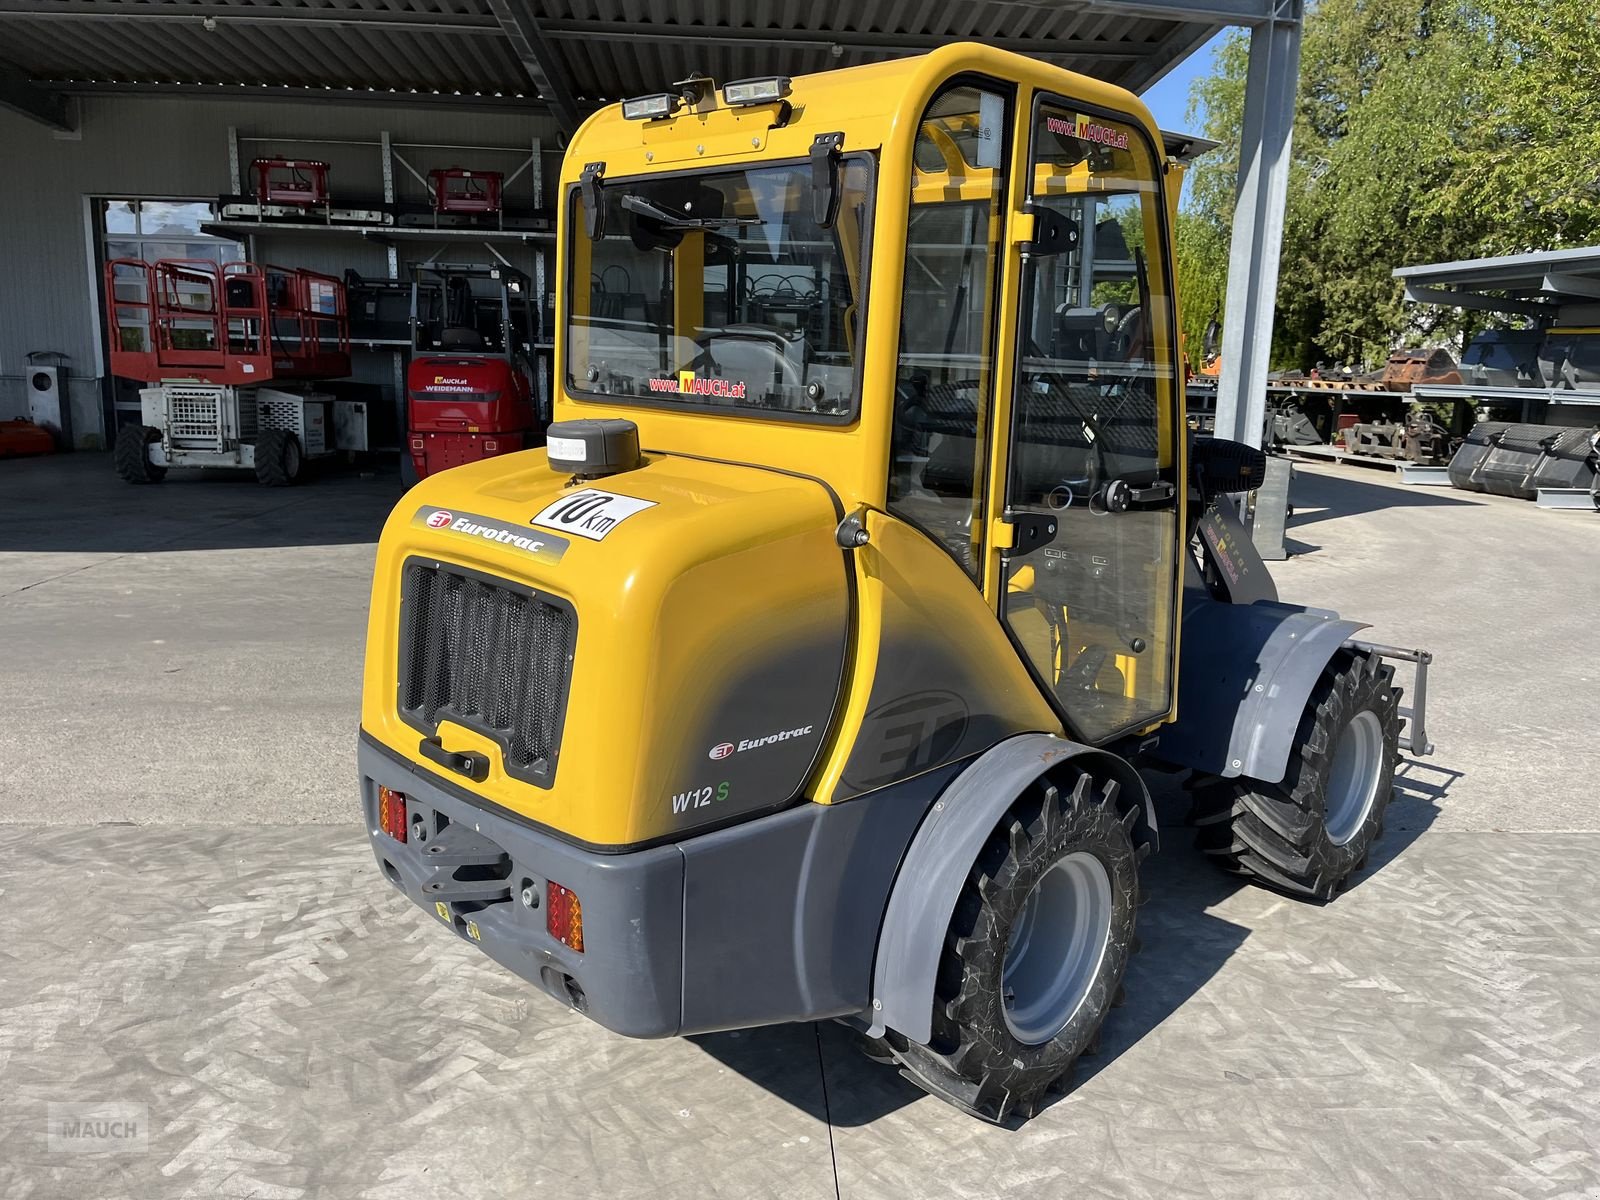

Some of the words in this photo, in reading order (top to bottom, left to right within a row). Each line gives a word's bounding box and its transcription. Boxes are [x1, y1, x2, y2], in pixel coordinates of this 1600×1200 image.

[1047, 116, 1128, 149] www.MAUCH.at
[425, 385, 473, 393] WEIDEMANN
[649, 377, 745, 399] www.MAUCH.at
[548, 493, 614, 524] 10
[451, 517, 545, 552] Eurotrac
[737, 725, 813, 752] Eurotrac
[672, 786, 713, 814] W12
[716, 781, 730, 801] S
